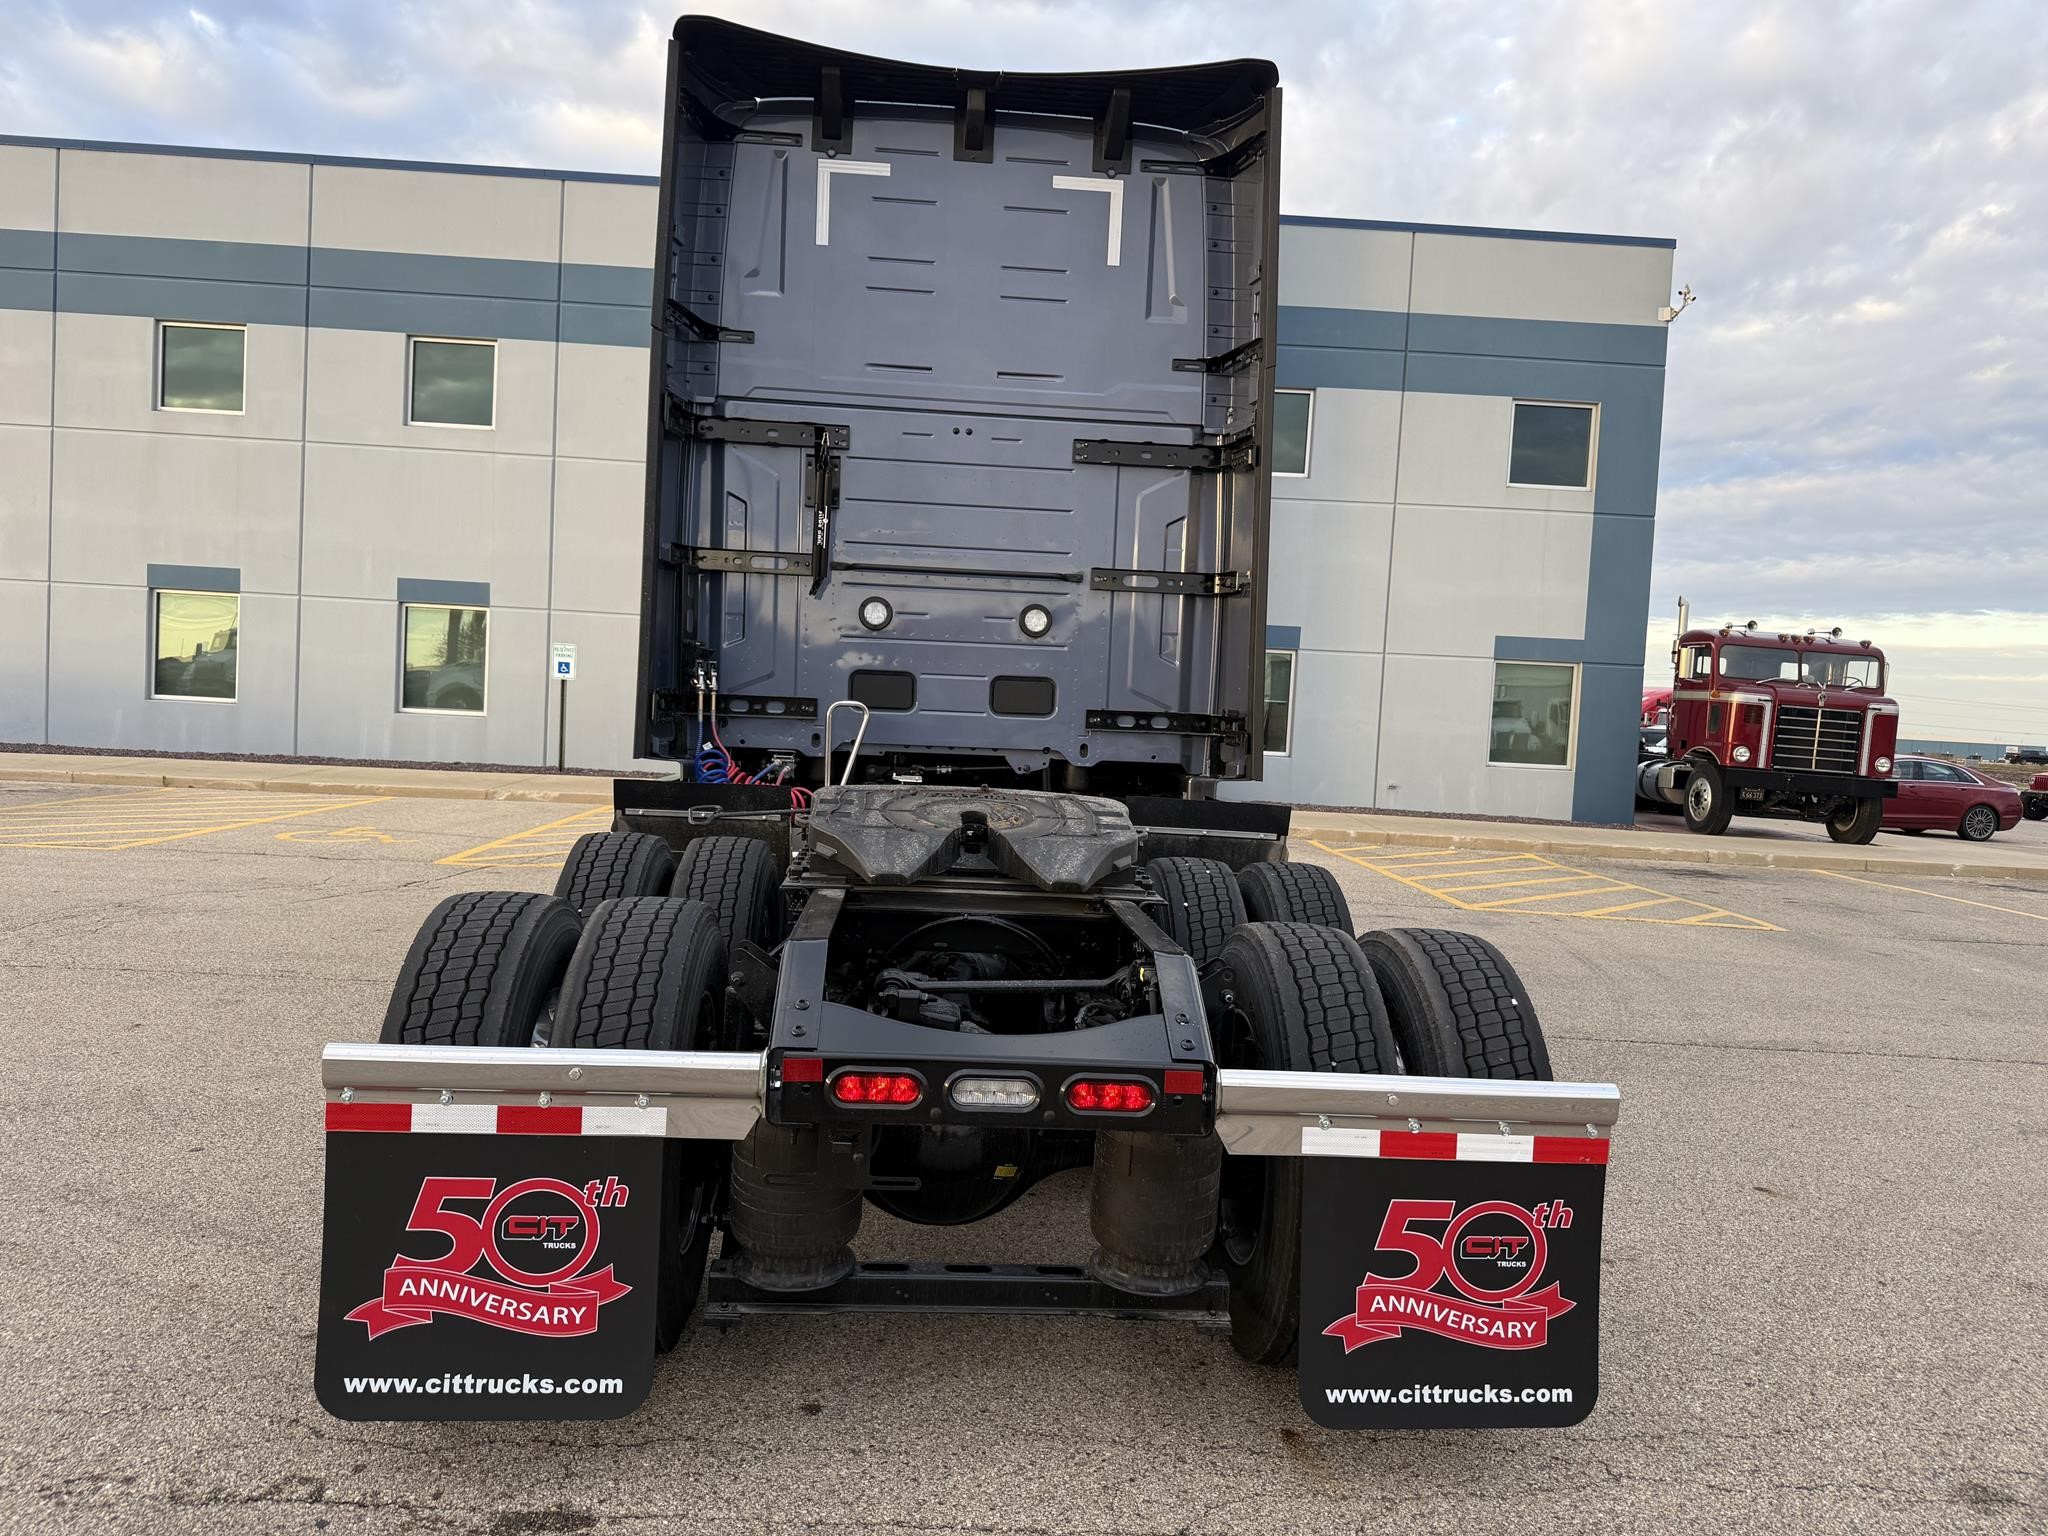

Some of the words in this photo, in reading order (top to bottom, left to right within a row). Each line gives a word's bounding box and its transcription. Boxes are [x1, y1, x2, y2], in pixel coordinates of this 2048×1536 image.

[502, 1215, 579, 1240] CIT
[1460, 1236, 1529, 1259] CIT
[399, 1278, 587, 1325] ANNIVERSARY
[1370, 1295, 1538, 1339] ANNIVERSARY
[343, 1373, 624, 1394] www.cittrucks.com
[1325, 1384, 1573, 1403] www.cittrucks.com
